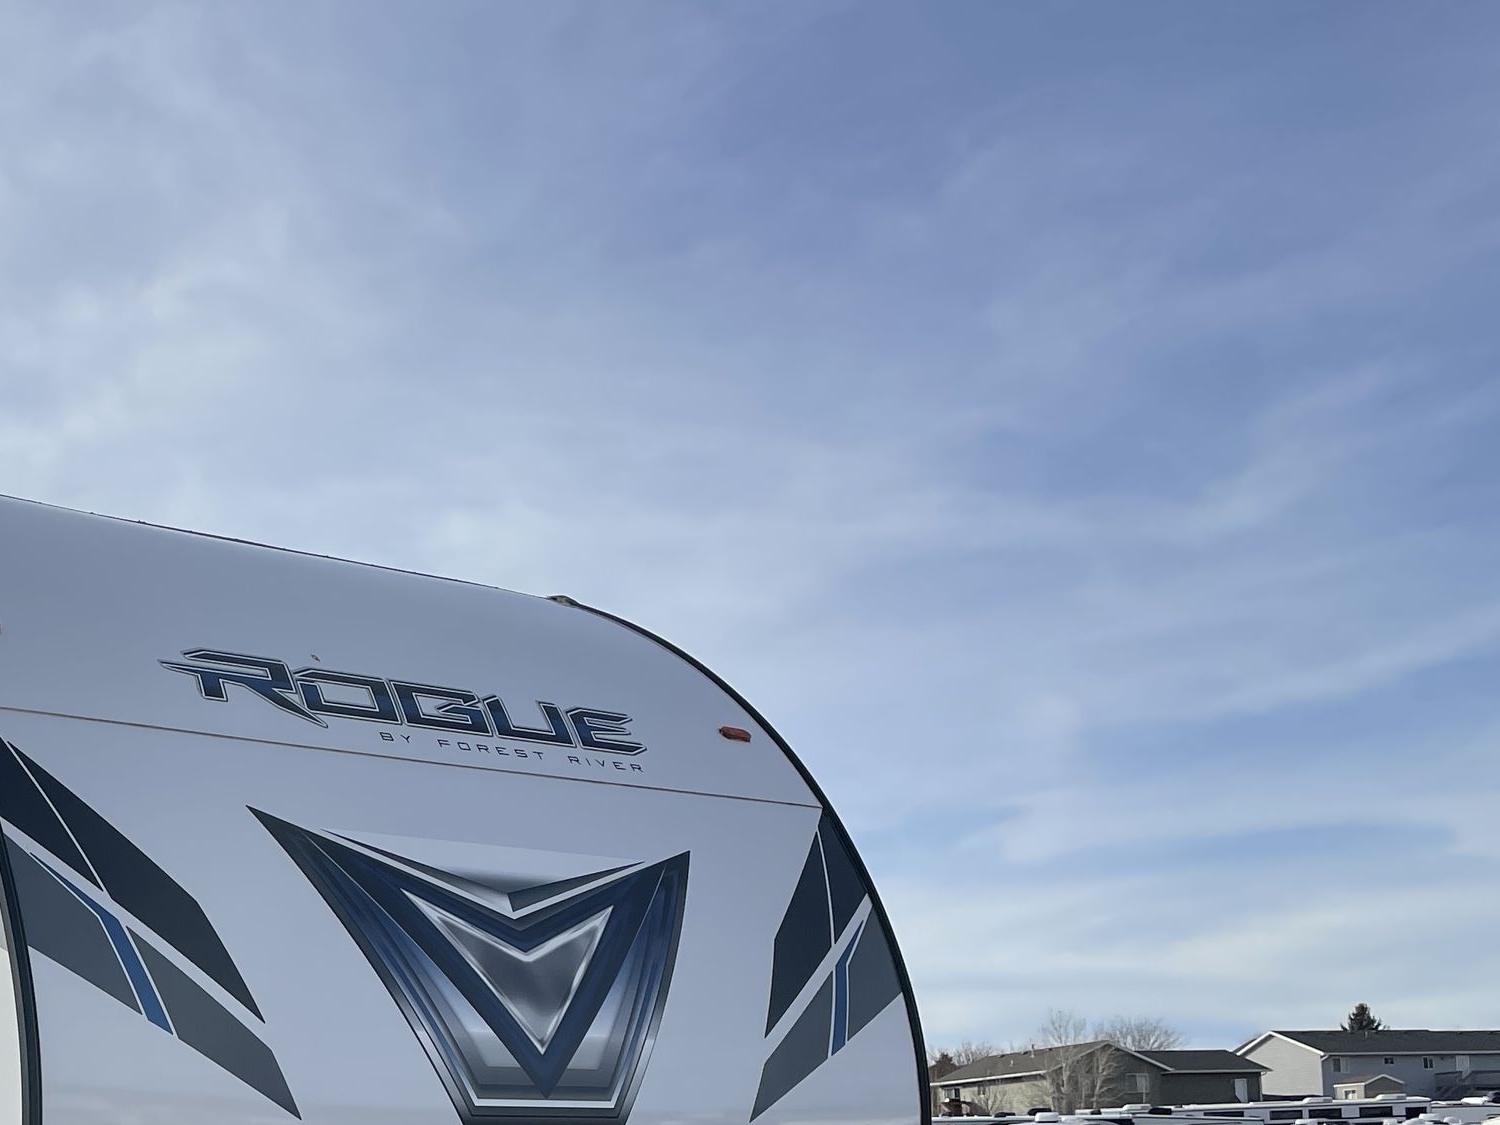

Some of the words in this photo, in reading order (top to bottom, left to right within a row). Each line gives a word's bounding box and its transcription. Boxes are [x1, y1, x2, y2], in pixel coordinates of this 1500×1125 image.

[157, 646, 649, 757] ROGUE
[379, 731, 412, 745] BY
[436, 738, 544, 761] FOREST
[566, 755, 644, 774] RIVER
